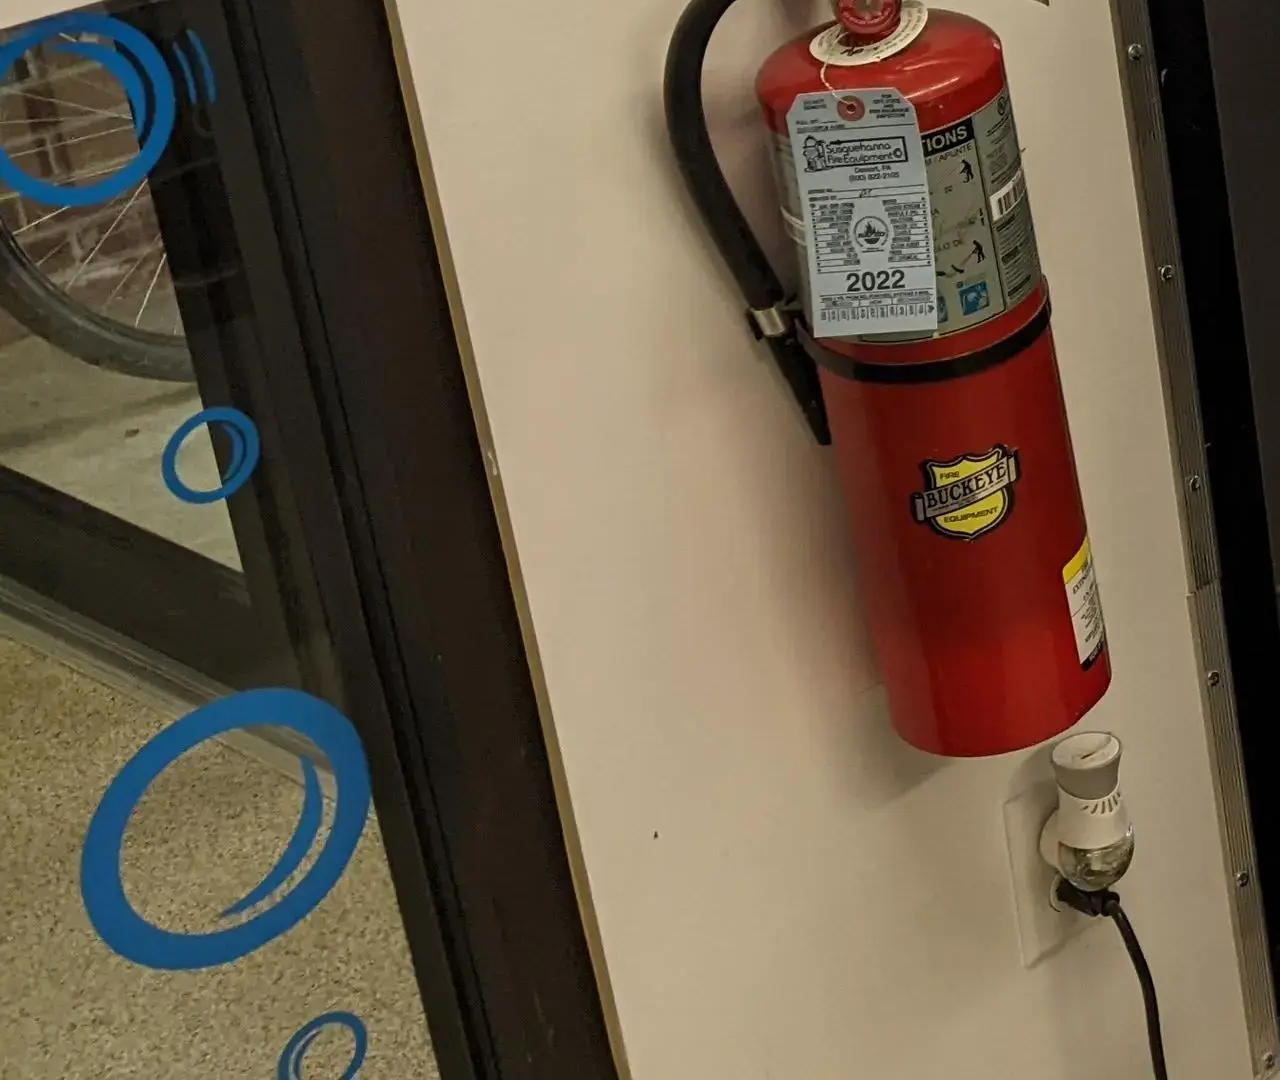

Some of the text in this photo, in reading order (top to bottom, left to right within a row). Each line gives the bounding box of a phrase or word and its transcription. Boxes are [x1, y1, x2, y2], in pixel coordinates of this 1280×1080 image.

[826, 141, 892, 159] Susquehanna
[921, 125, 968, 152] IONS
[846, 269, 906, 293] 2022
[926, 463, 1007, 509] BUCKEYE
[943, 505, 999, 524] EQUIPMENT
